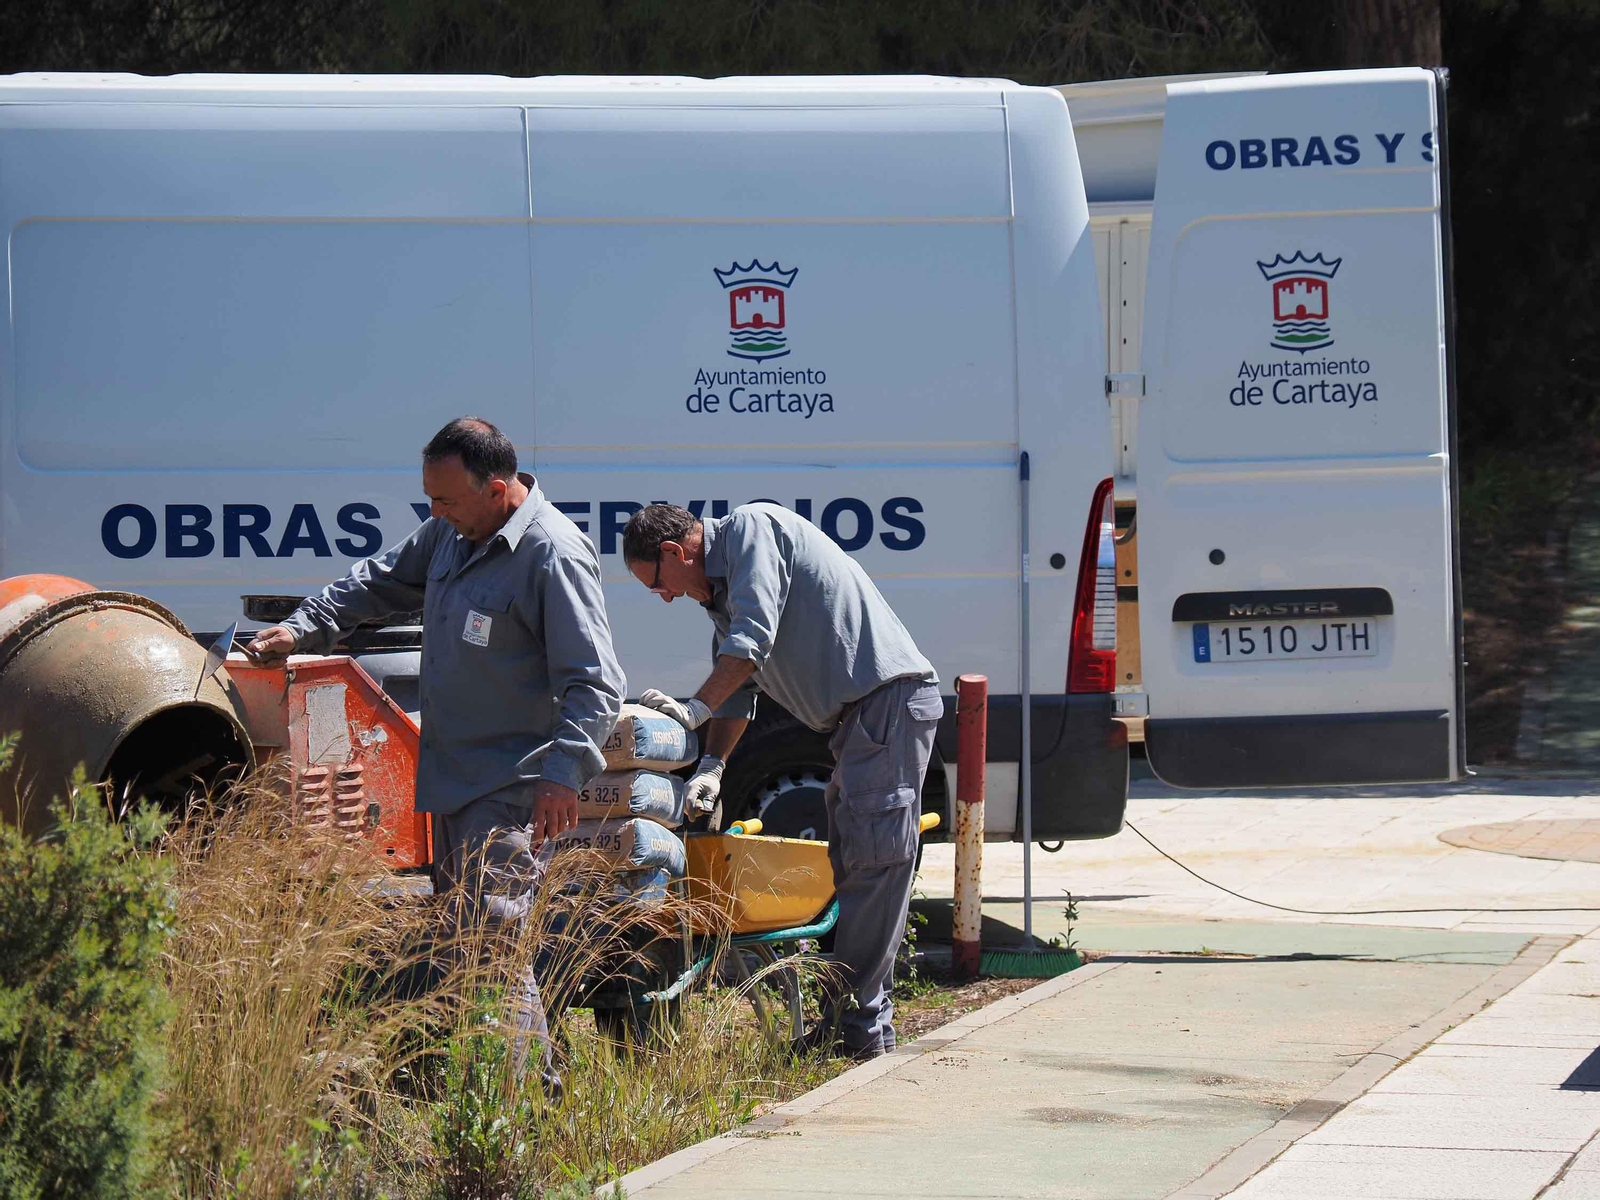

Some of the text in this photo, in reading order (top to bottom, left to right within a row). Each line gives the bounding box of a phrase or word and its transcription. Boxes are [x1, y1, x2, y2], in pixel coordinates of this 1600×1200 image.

[1205, 135, 1361, 171] OBRAS
[1375, 132, 1406, 163] Y
[693, 367, 827, 390] Ayuntamiento
[1238, 357, 1371, 382] Ayuntamiento
[686, 387, 835, 419] de Cartaya
[1229, 378, 1379, 409] de Cartaya
[101, 502, 384, 559] OBRAS
[1229, 601, 1341, 616] MASTER
[1220, 622, 1370, 656] 1510 JTH
[601, 732, 622, 751] 2,5
[595, 787, 619, 804] 32,5
